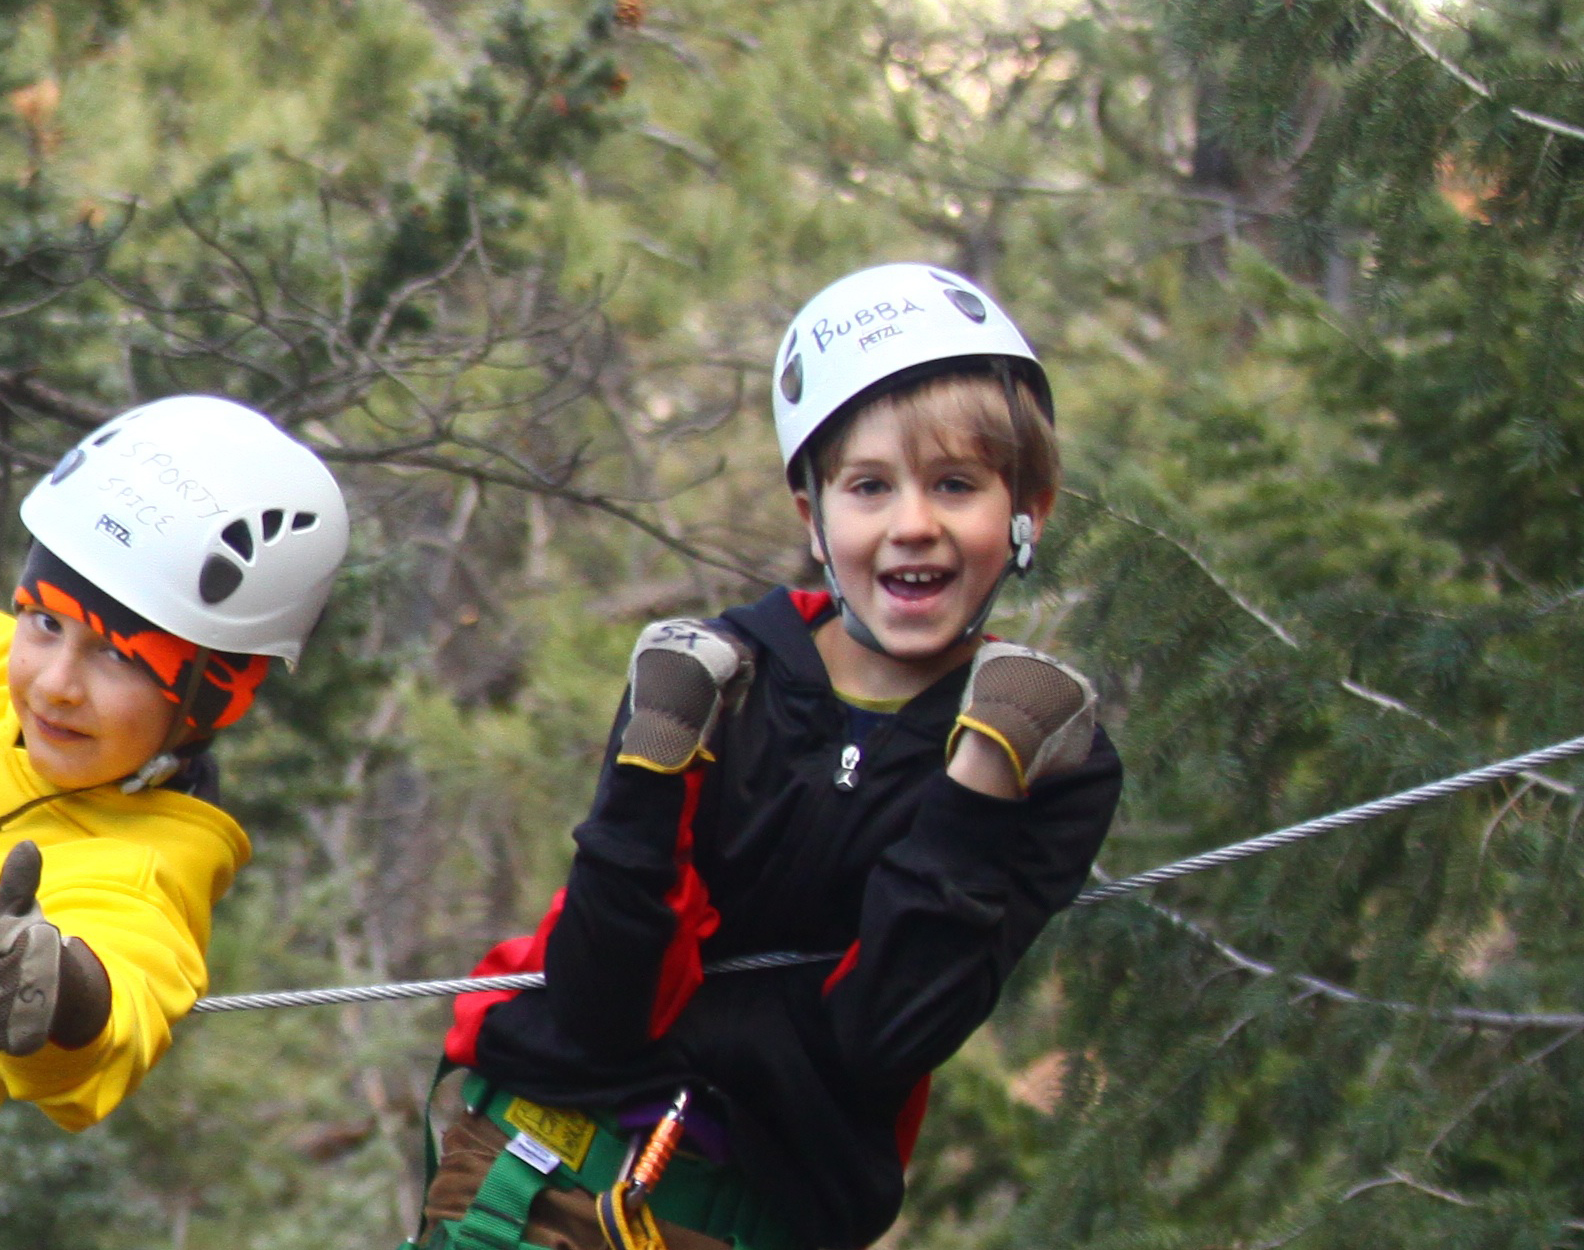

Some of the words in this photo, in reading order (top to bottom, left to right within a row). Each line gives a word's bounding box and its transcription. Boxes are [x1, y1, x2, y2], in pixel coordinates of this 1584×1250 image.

[858, 326, 903, 352] PETZL
[120, 442, 228, 519] SPORTY
[99, 478, 174, 536] SPICE
[95, 514, 132, 548] PETZL
